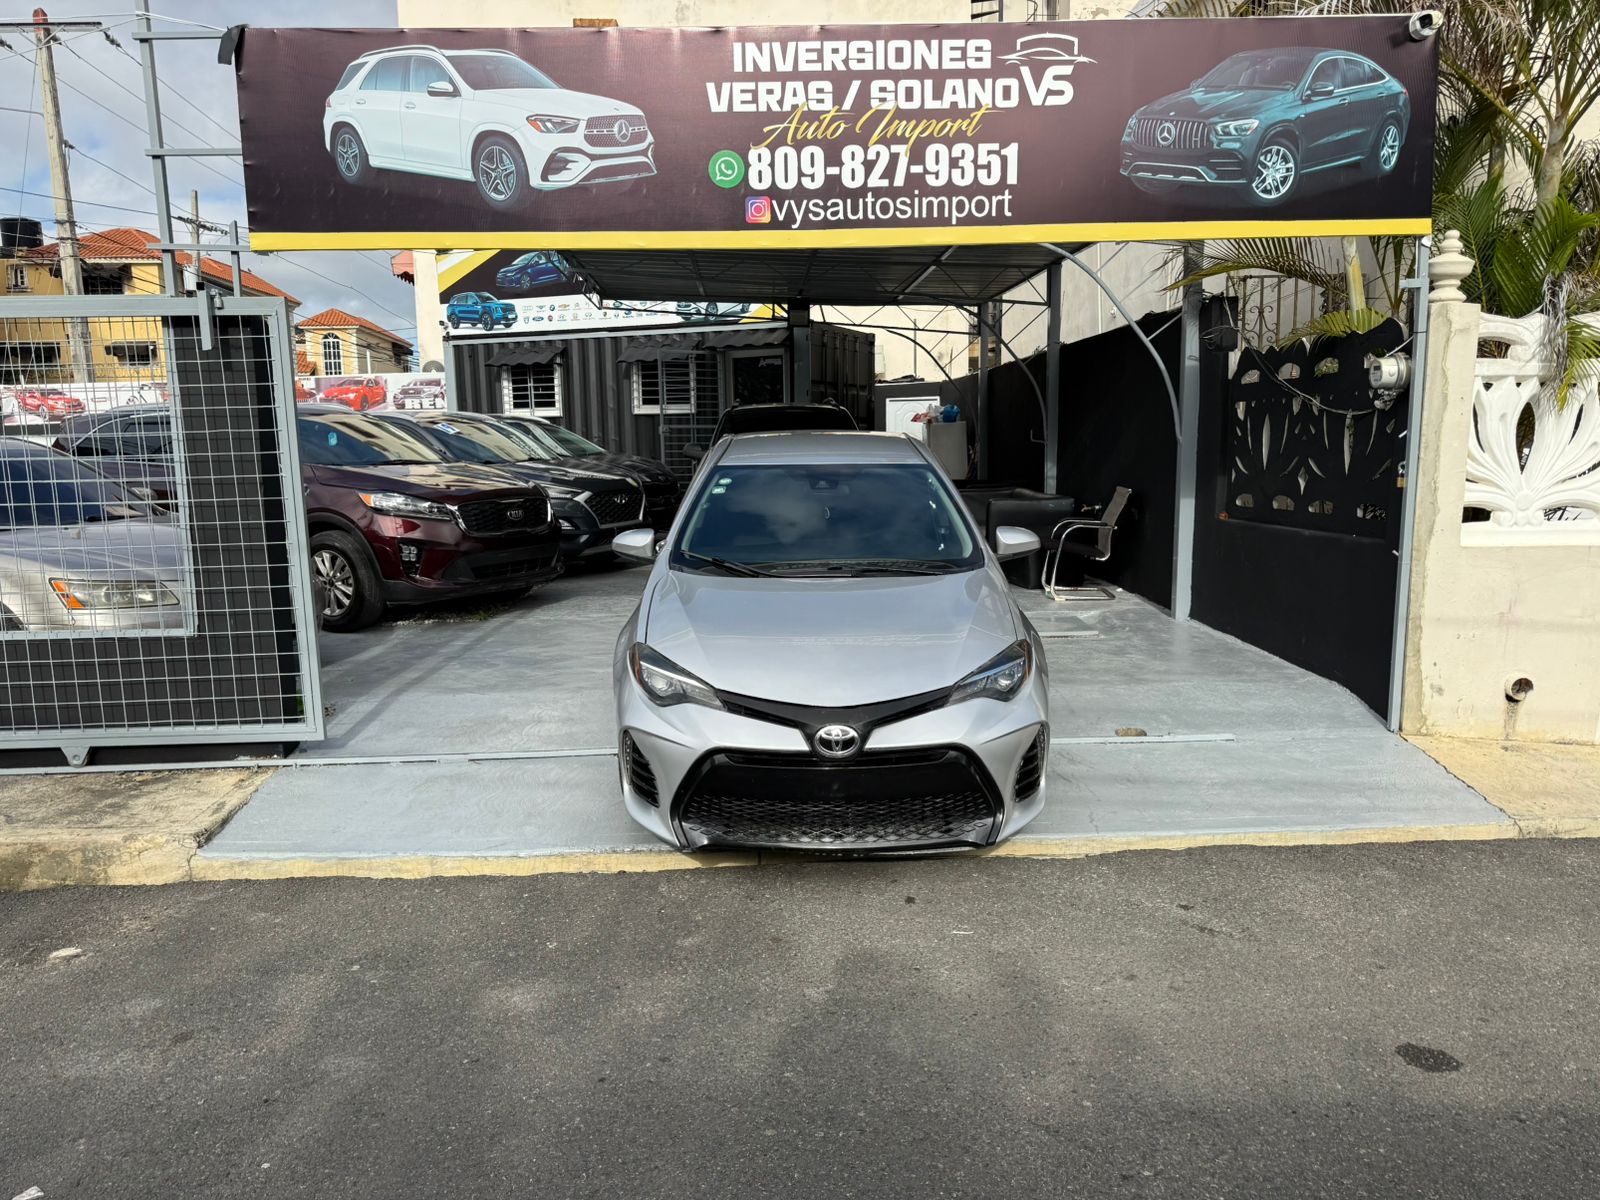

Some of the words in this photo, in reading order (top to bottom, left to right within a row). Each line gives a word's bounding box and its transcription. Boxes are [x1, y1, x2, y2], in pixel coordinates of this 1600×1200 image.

[732, 39, 992, 73] INVERSIONES
[705, 80, 834, 113] VERAS
[840, 79, 862, 111] /
[870, 77, 1020, 110] SOLANO
[1019, 64, 1075, 107] VS
[749, 101, 854, 150] Auto
[855, 100, 1005, 157] Import
[747, 142, 1019, 191] 809-827-9351
[771, 189, 1013, 229] vysautosimport
